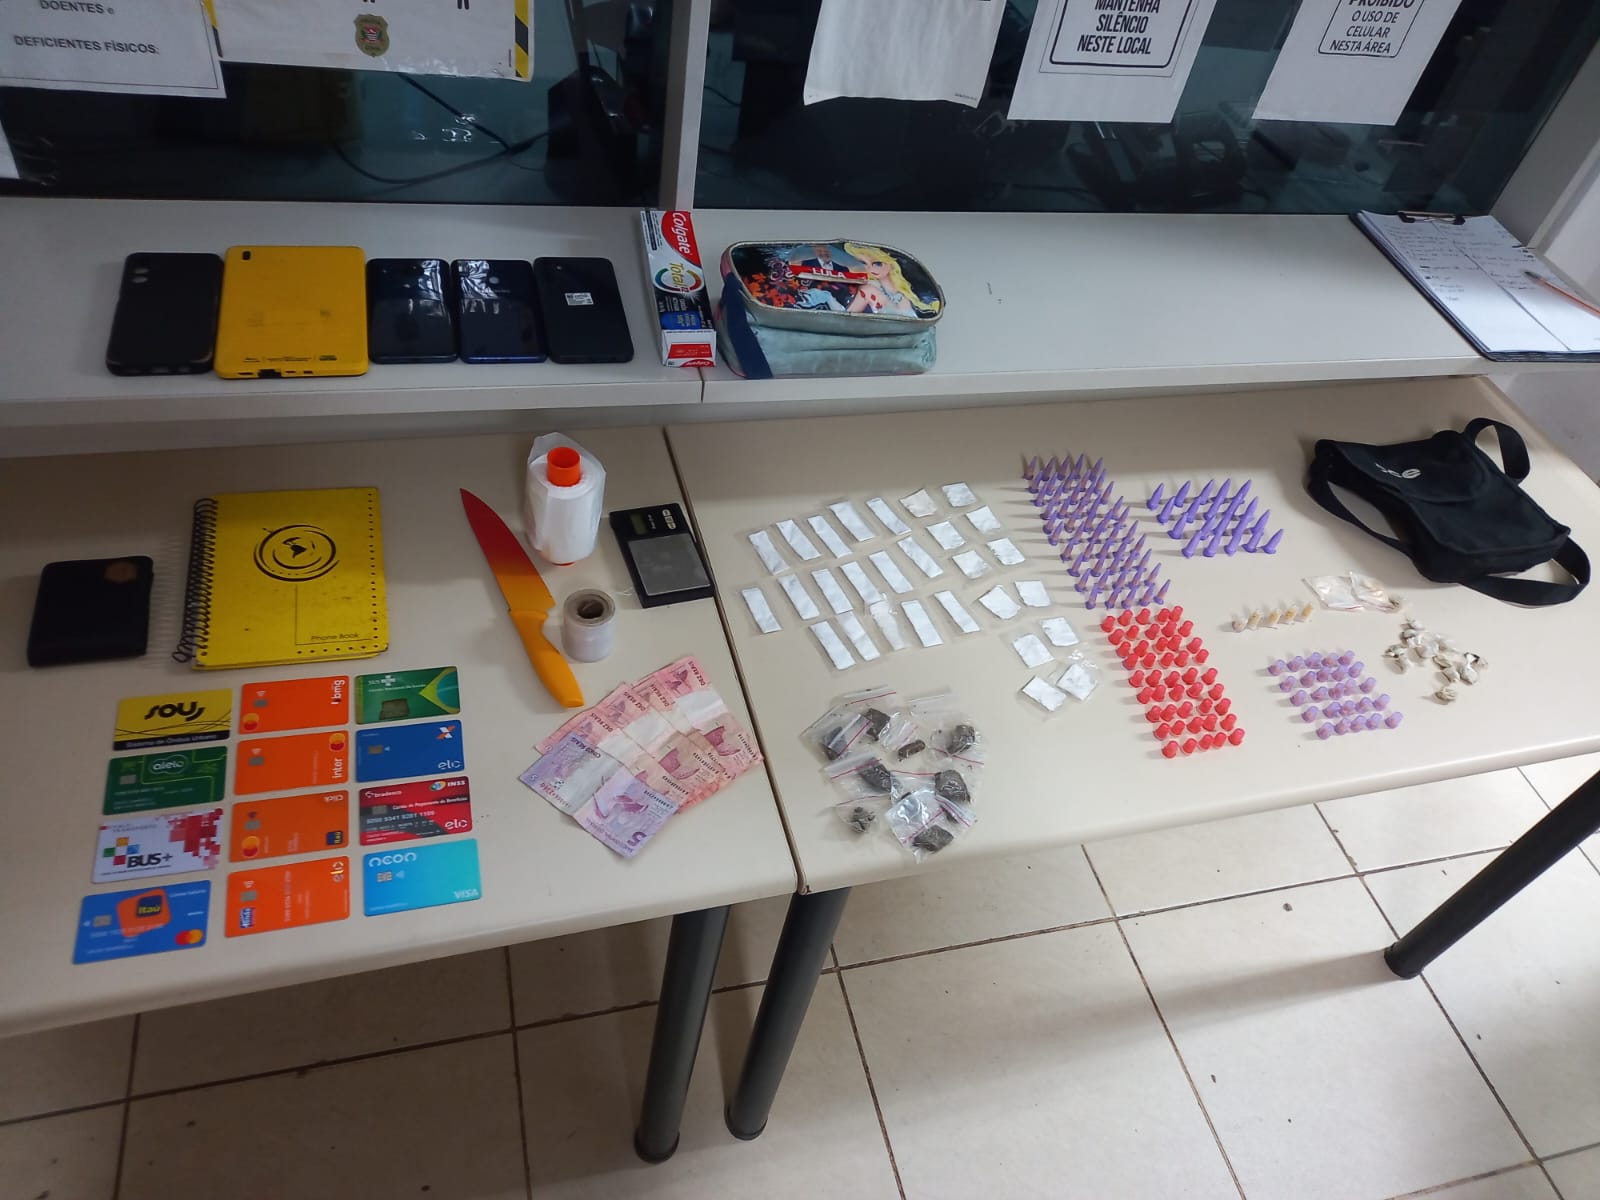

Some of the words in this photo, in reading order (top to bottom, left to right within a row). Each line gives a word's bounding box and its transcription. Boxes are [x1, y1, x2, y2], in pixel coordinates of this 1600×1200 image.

[39, 0, 104, 14] DOENTES
[1096, 11, 1149, 33] SILÊNCIO
[1352, 10, 1361, 22] O
[1362, 10, 1383, 23] USO
[1383, 12, 1400, 24] DE
[1346, 25, 1391, 38] CELULAR
[13, 34, 102, 51] DEFICIENTES
[1077, 34, 1117, 53] NESTE
[1116, 36, 1152, 54] LOCAL
[1329, 39, 1362, 52] NESTA
[1362, 38, 1391, 53] ÁREA
[672, 212, 691, 254] Colgate
[669, 262, 685, 287] Total
[812, 267, 846, 279] LULA
[311, 633, 338, 641] Phone
[332, 758, 343, 779] inter
[438, 760, 461, 770] elo
[445, 818, 468, 830] elo
[626, 831, 648, 847] 5
[368, 851, 417, 867] neon
[453, 888, 479, 899] VISA
